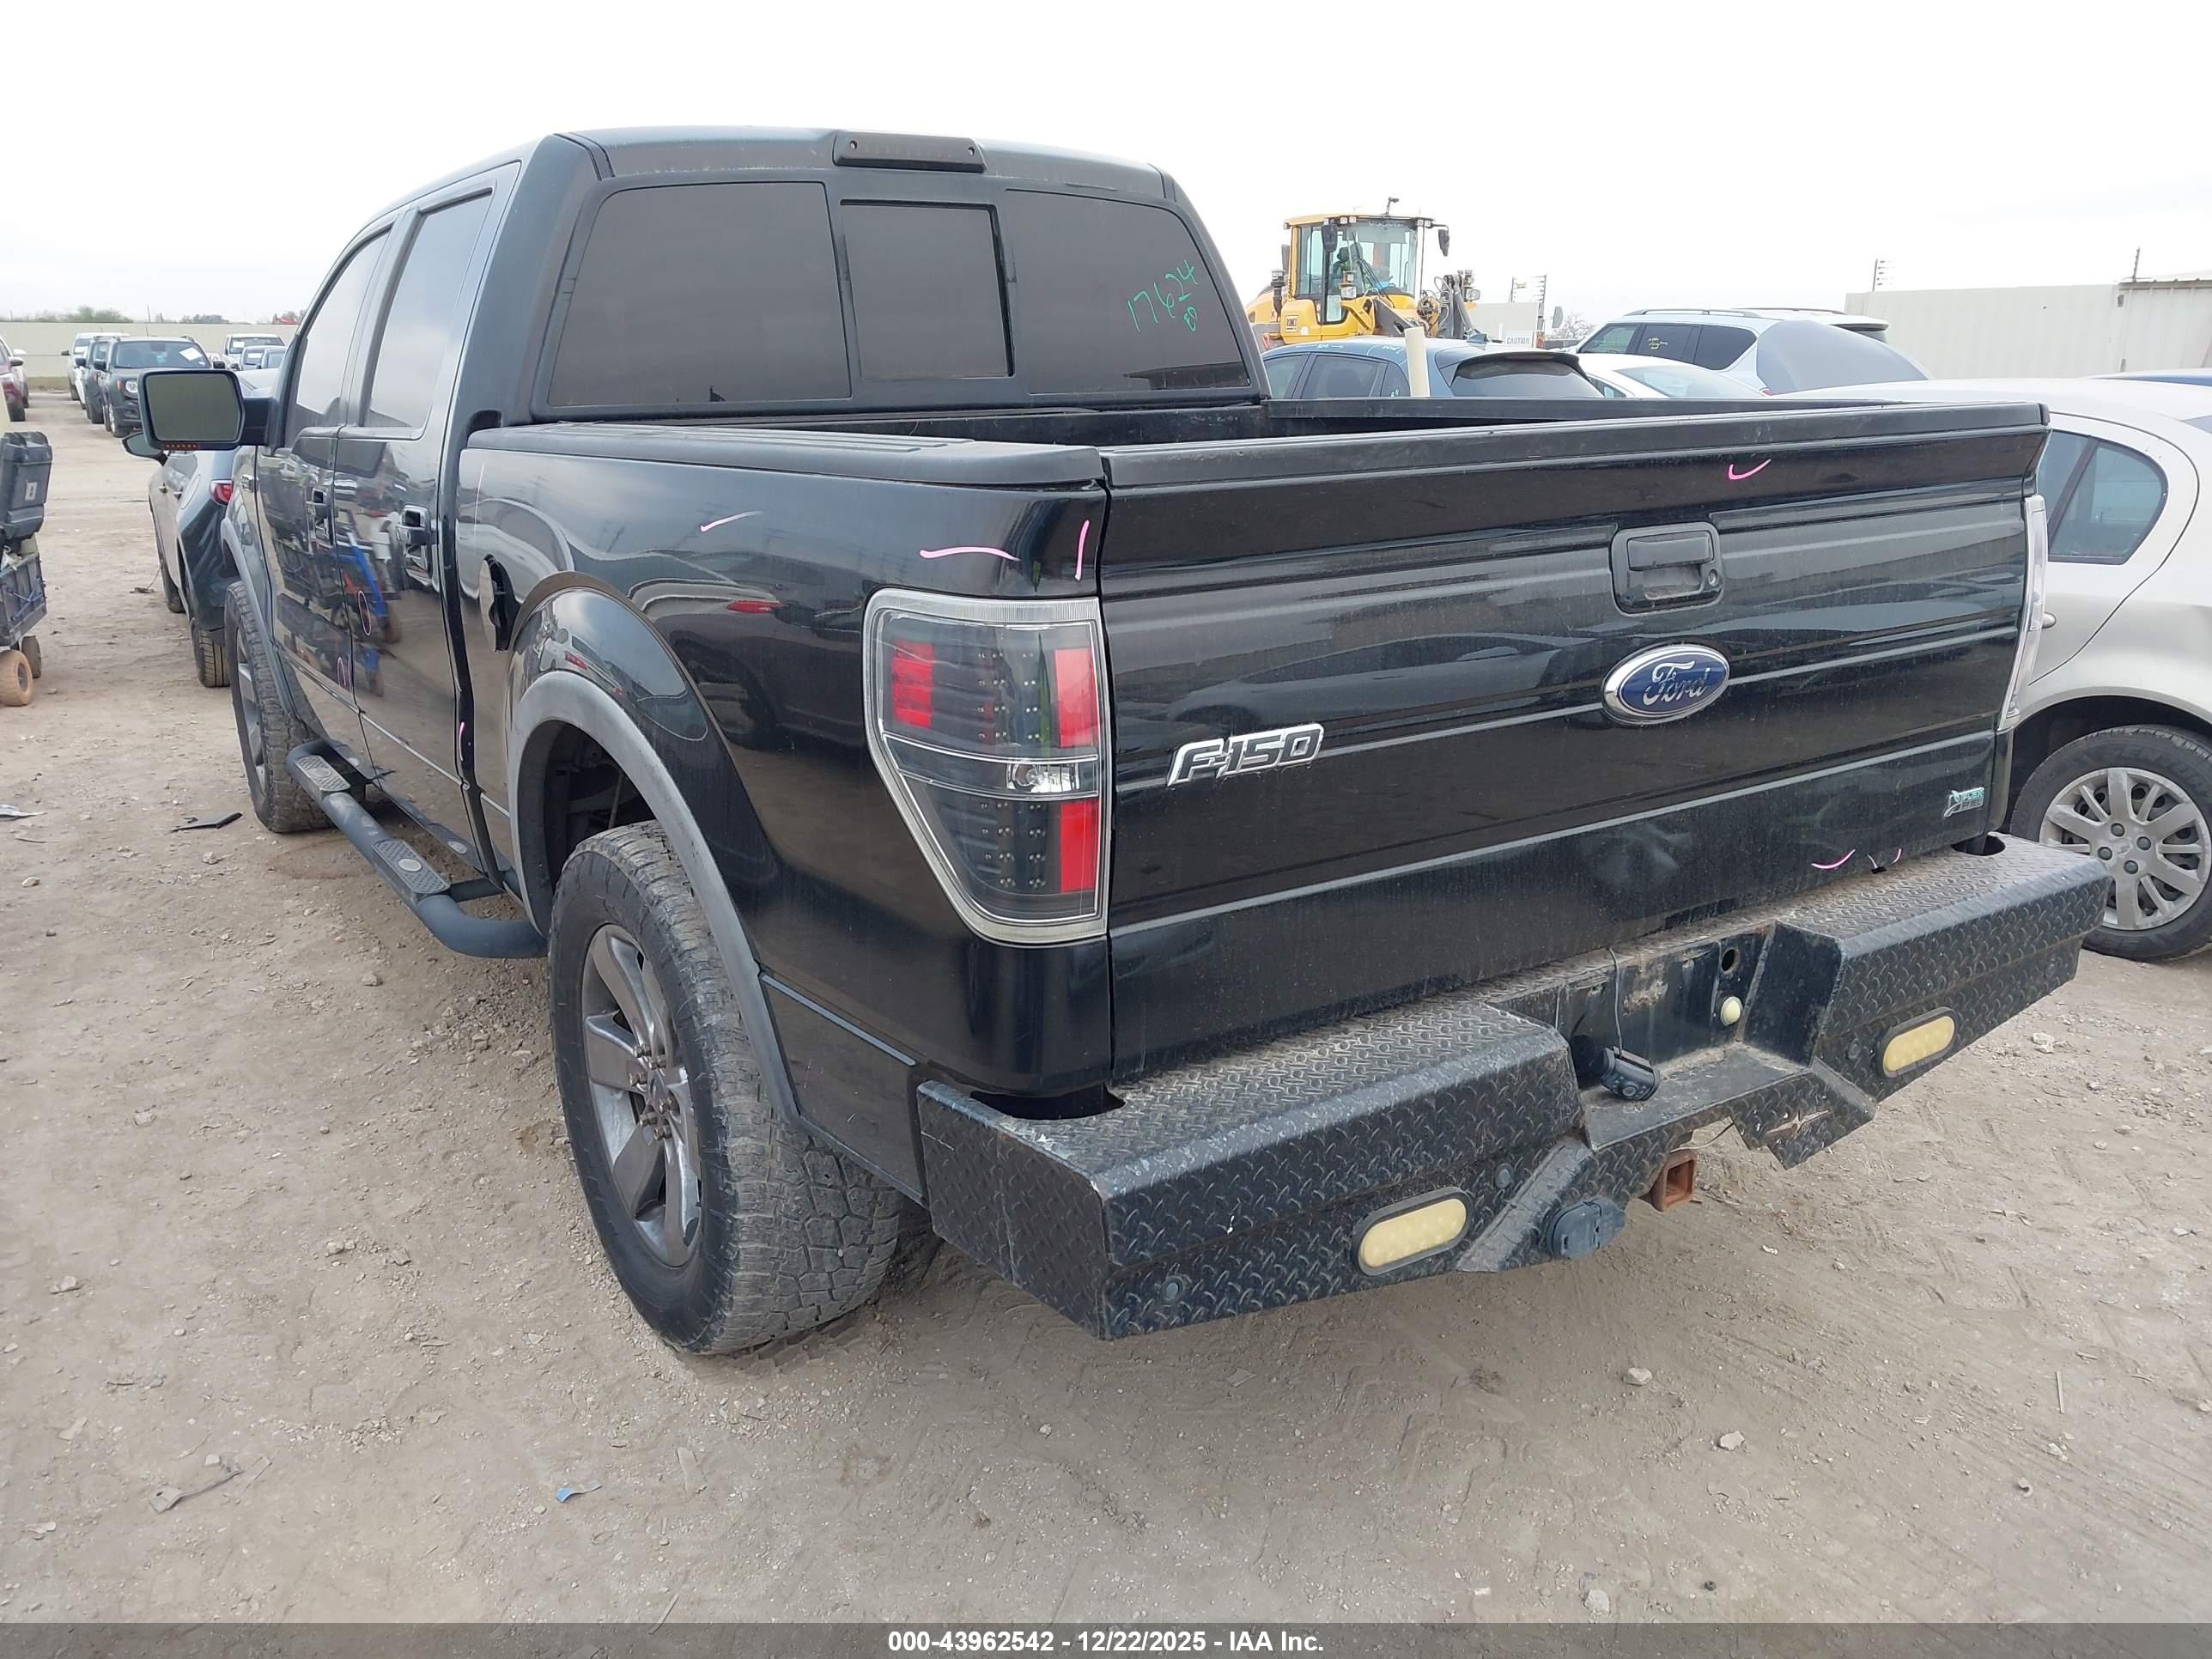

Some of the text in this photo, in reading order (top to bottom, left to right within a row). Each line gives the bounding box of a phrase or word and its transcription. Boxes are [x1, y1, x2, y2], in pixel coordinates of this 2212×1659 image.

[1127, 258, 1199, 332] 17624
[1506, 336, 1530, 344] CAUTION
[1642, 659, 1711, 706] Ford
[1167, 722, 1324, 787] F-150
